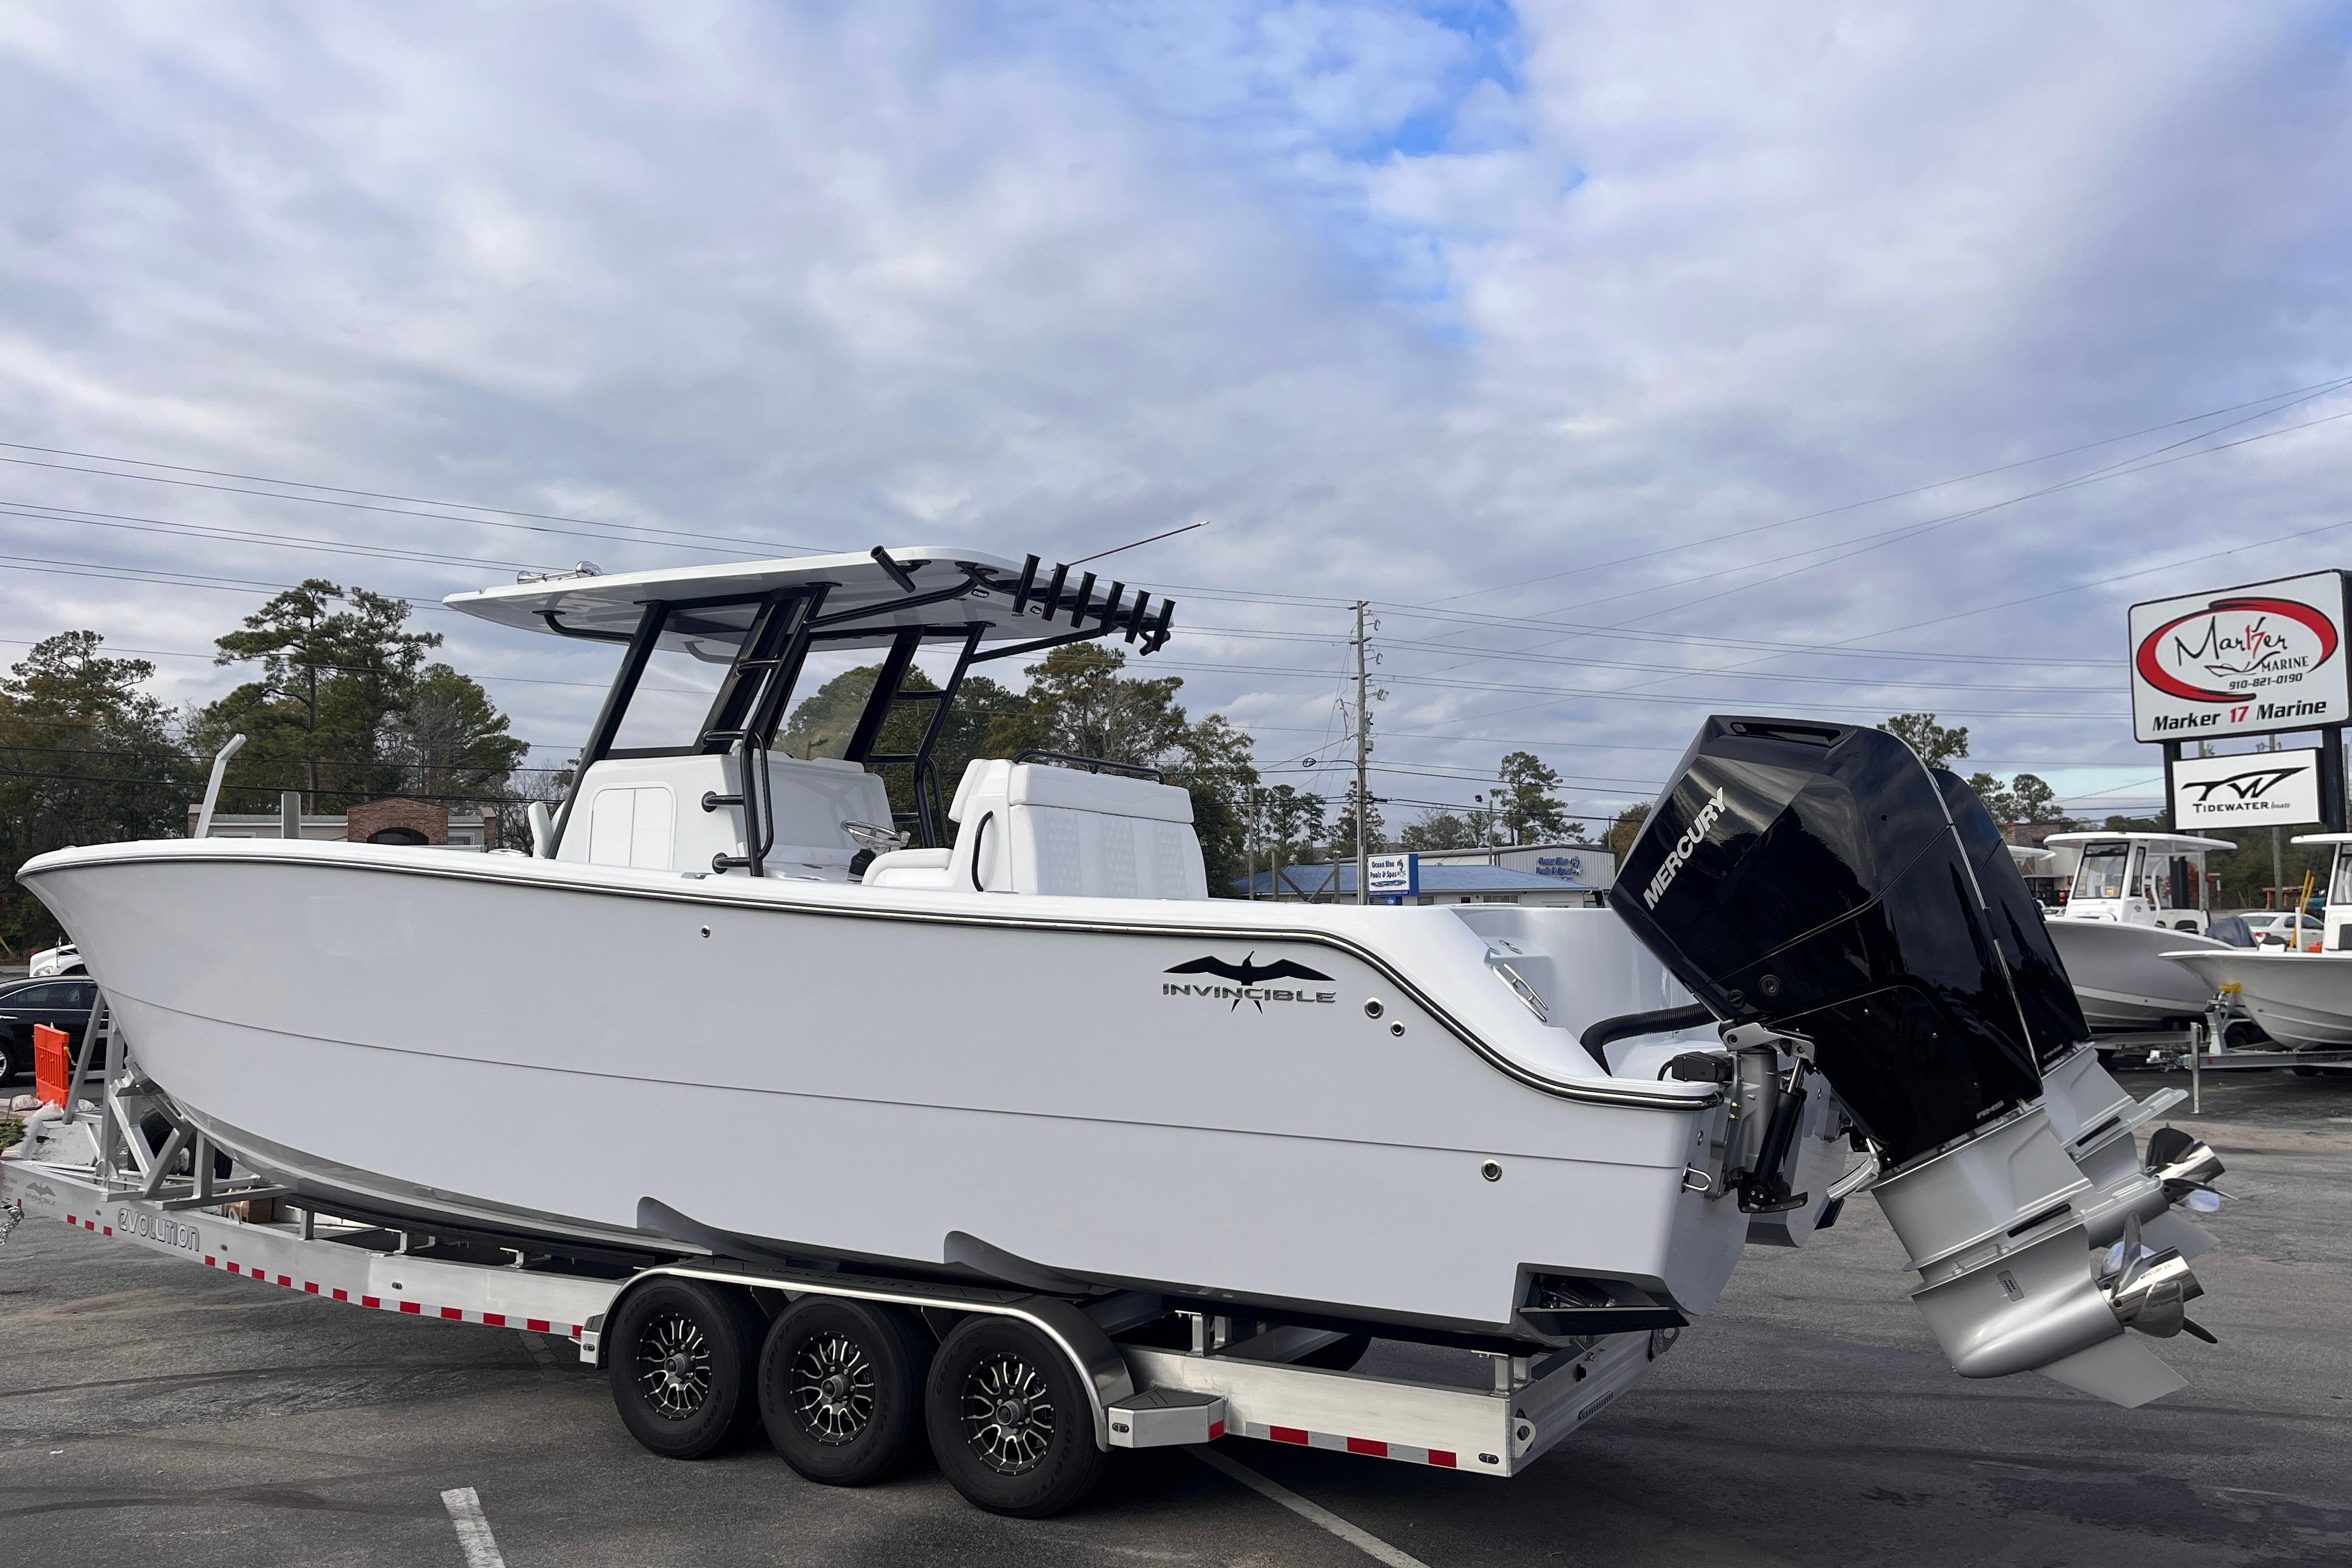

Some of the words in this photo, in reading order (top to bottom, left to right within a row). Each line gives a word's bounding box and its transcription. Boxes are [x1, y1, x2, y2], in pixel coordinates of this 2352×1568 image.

[2261, 656, 2309, 673] MARINE
[2228, 673, 2303, 690] 910-821-0190
[2152, 712, 2221, 732] Marker
[2230, 705, 2249, 723] 17
[2256, 700, 2327, 721] Marine
[2192, 801, 2270, 813] TIDEWATER
[1643, 786, 1726, 911] MERCURY
[1163, 983, 1337, 1003] INVINCIBLE
